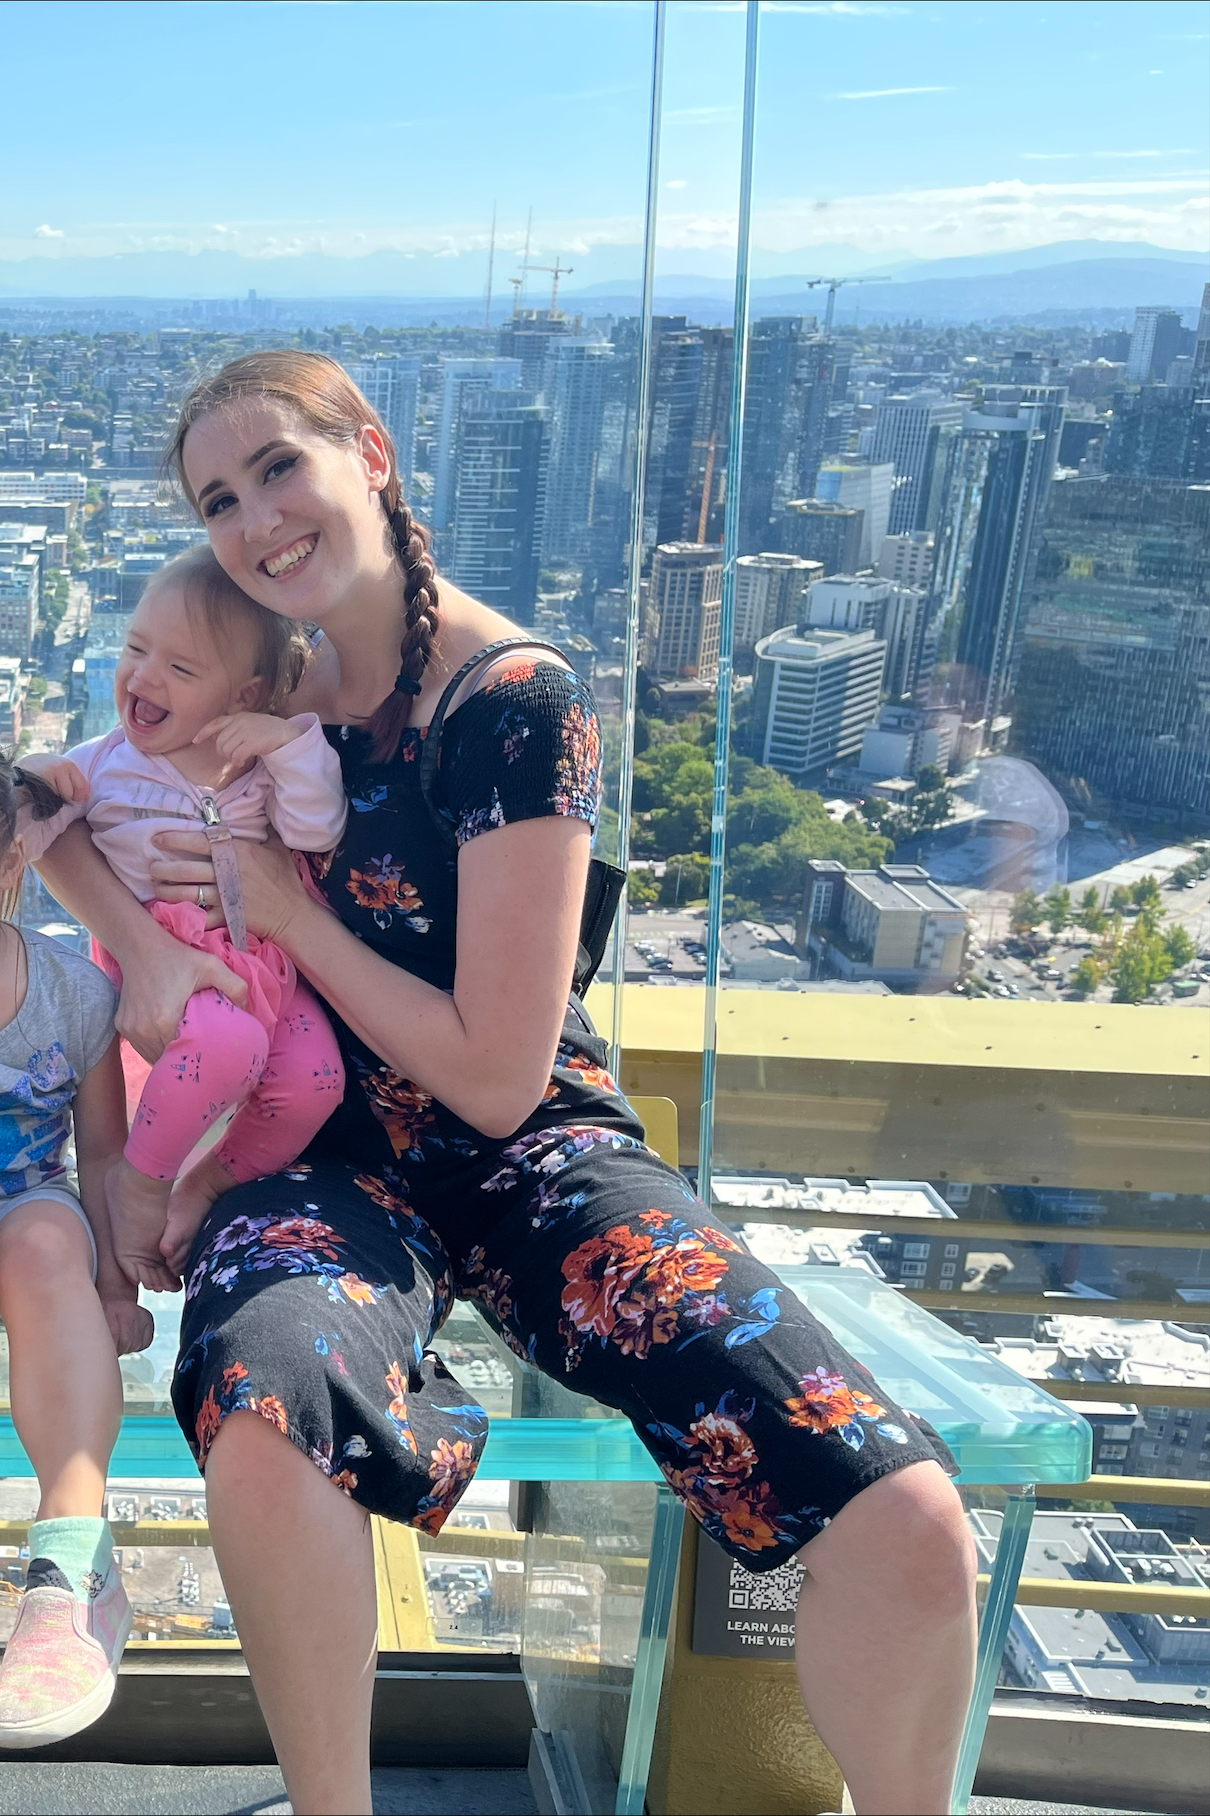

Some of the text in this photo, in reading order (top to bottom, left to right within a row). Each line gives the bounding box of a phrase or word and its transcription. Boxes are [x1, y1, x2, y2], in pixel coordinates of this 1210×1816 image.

[727, 1621, 795, 1634] LEARN ABO
[740, 1634, 764, 1645] THE
